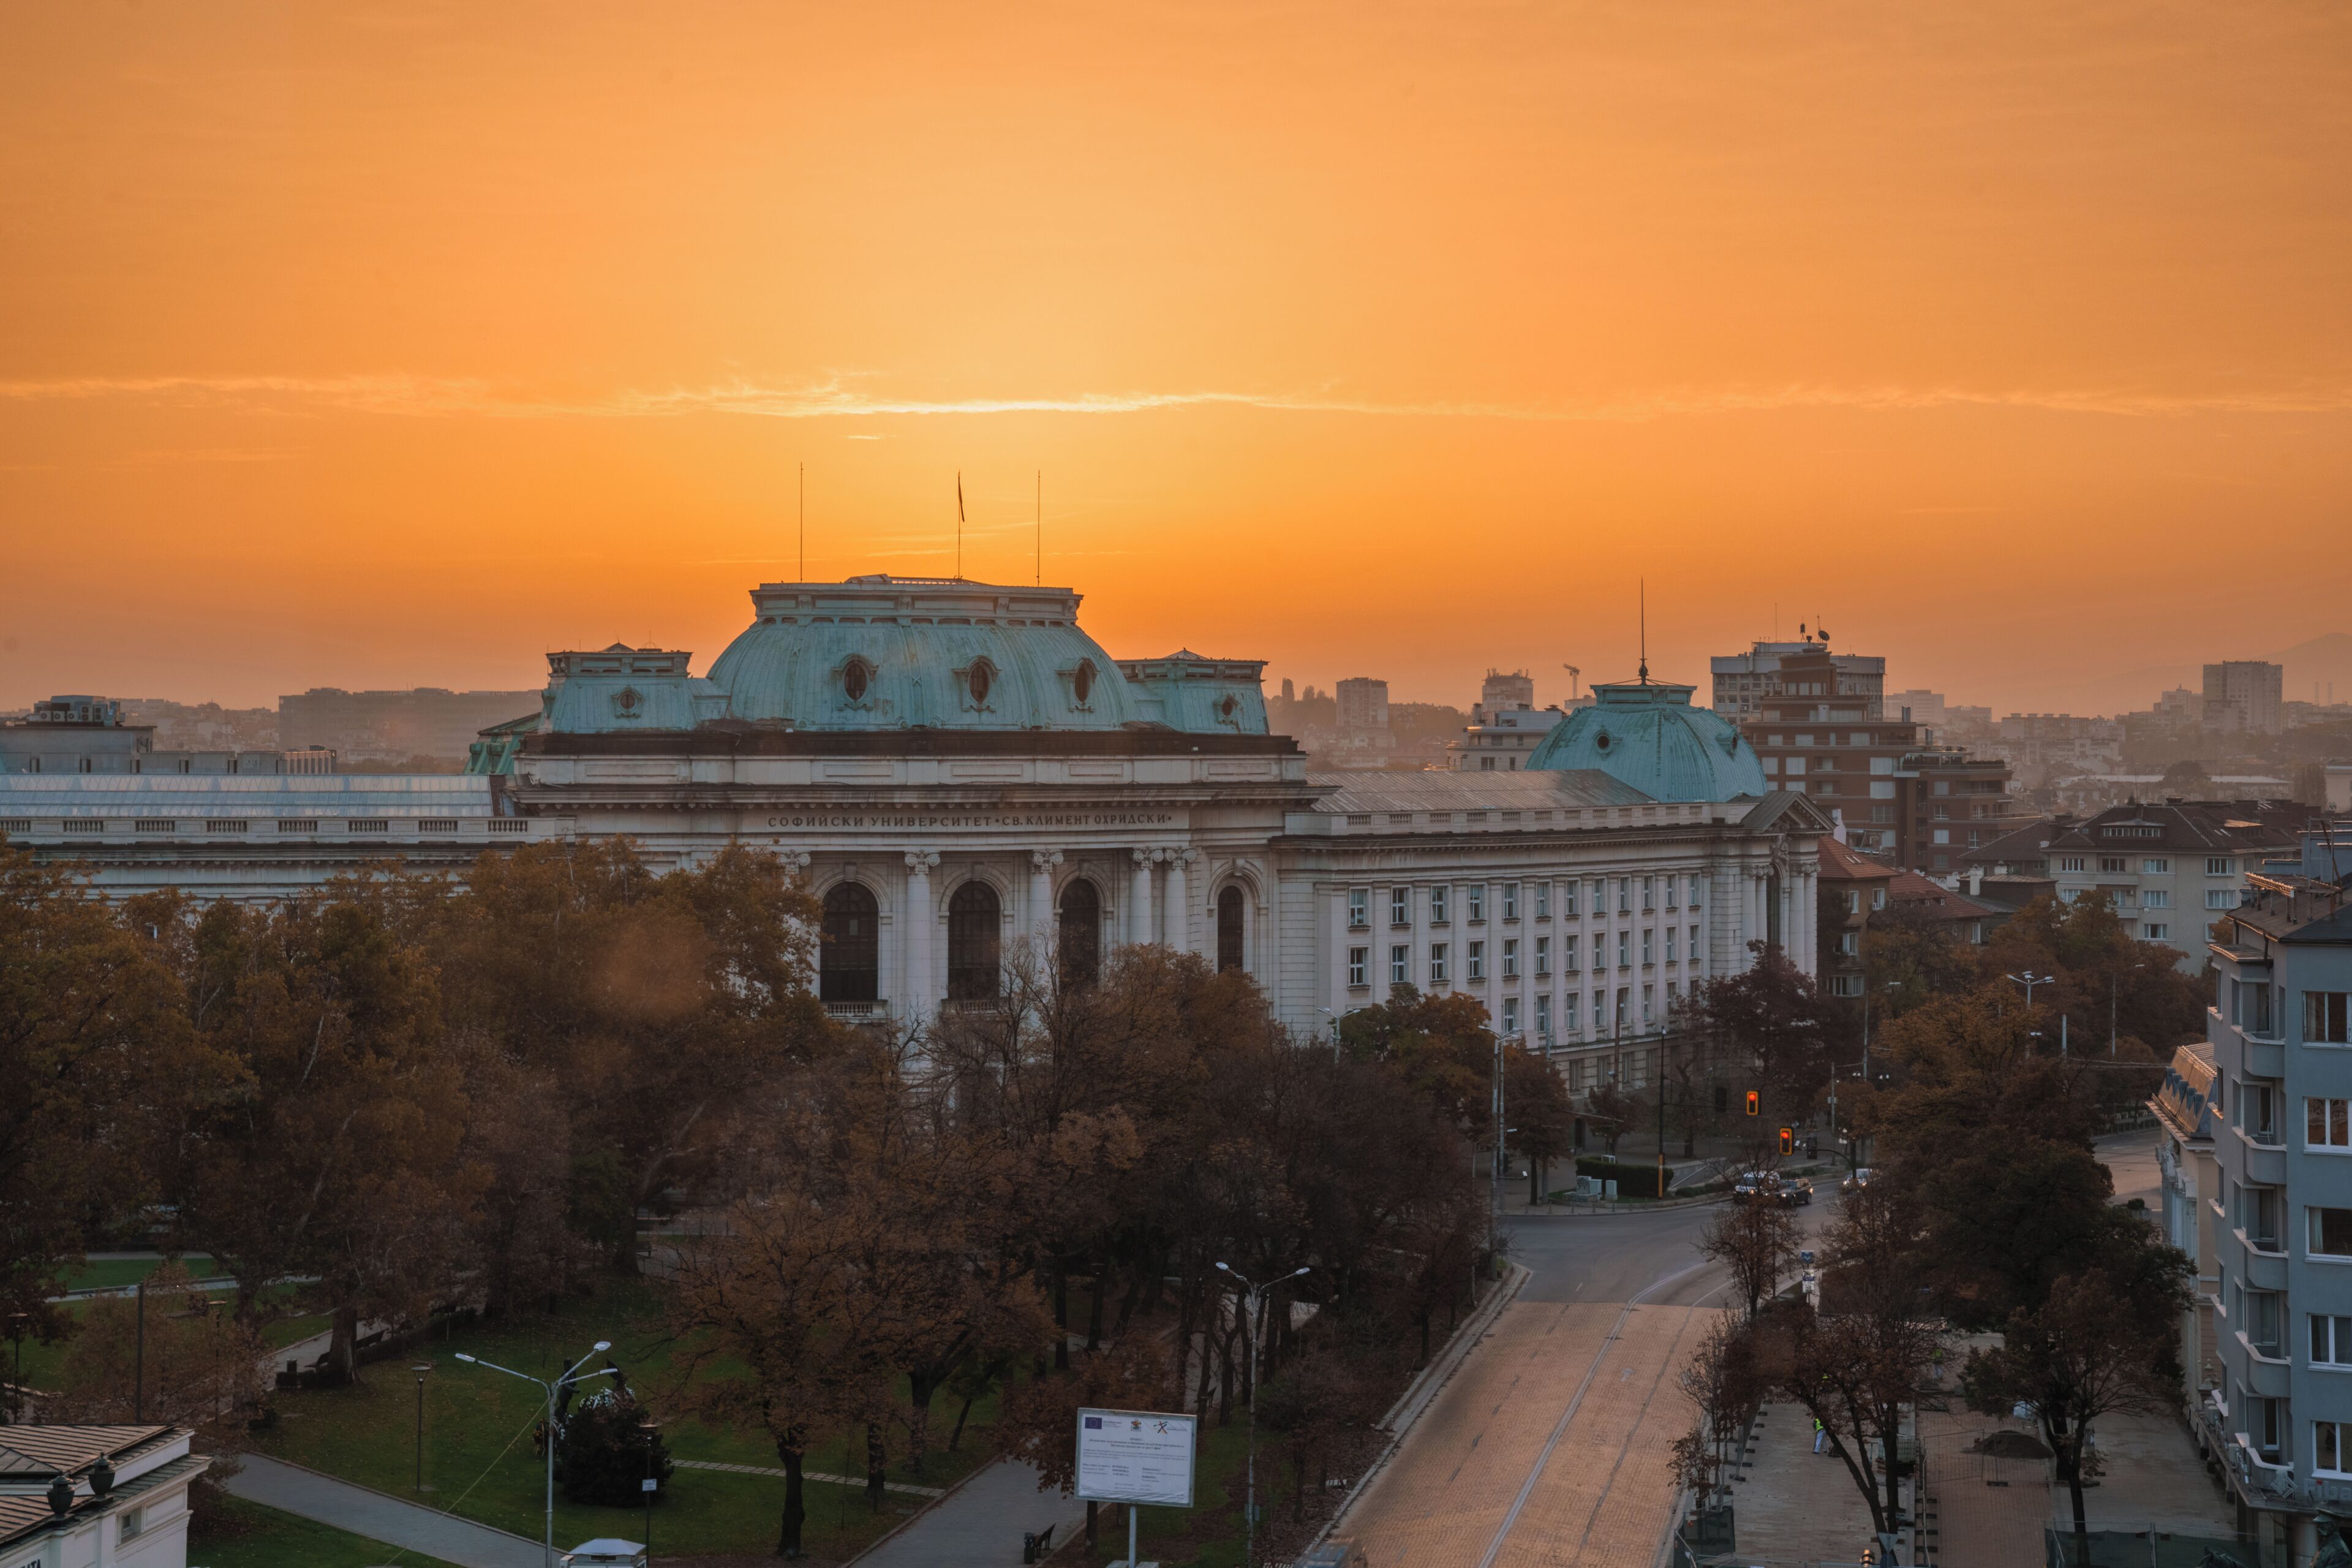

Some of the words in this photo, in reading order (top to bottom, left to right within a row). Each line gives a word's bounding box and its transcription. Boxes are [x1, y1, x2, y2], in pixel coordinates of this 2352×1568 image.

[768, 815, 863, 827] СОФИЙСКИ
[870, 816, 991, 827] УНИВЕРСИТЕТ
[1002, 816, 1022, 826] СВ.
[1027, 815, 1090, 825] КЛИМЕНТ
[1094, 814, 1165, 824] ОХРИДСКИ
